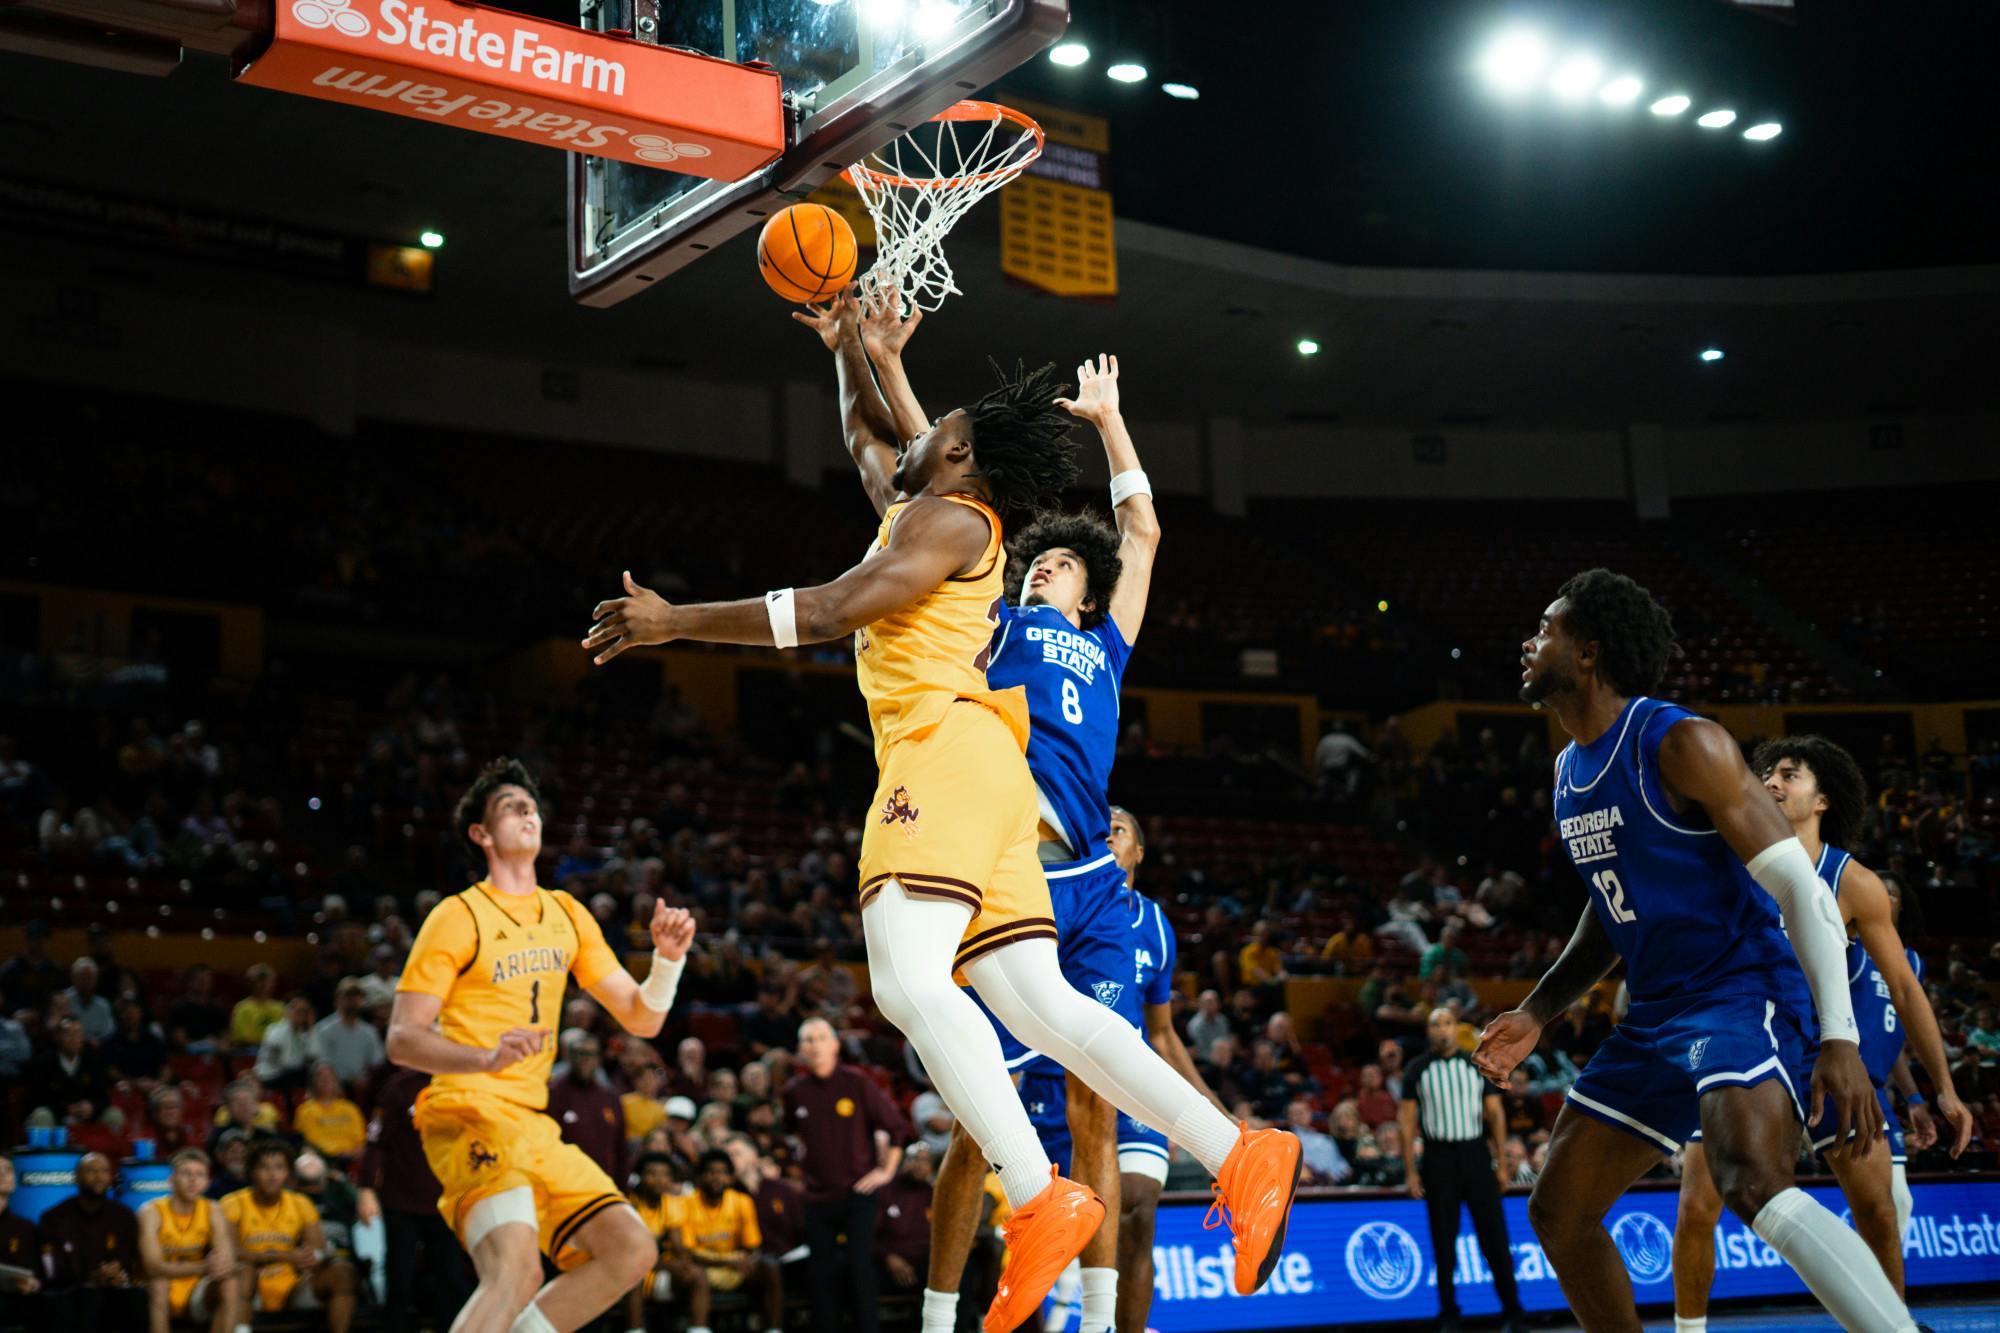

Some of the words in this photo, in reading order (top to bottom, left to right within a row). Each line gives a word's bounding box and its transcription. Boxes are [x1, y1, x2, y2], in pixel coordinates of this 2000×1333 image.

[1025, 626, 1106, 671] GEORGIA
[1042, 642, 1097, 681] STATE
[1061, 678, 1083, 725] 8
[1560, 806, 1624, 839] GEORGIA
[1569, 831, 1616, 859] STATE
[1592, 869, 1637, 924] 12
[530, 979, 540, 1024] 1
[1883, 1003, 1897, 1033] 6
[1903, 1213, 2000, 1259] Allstat
